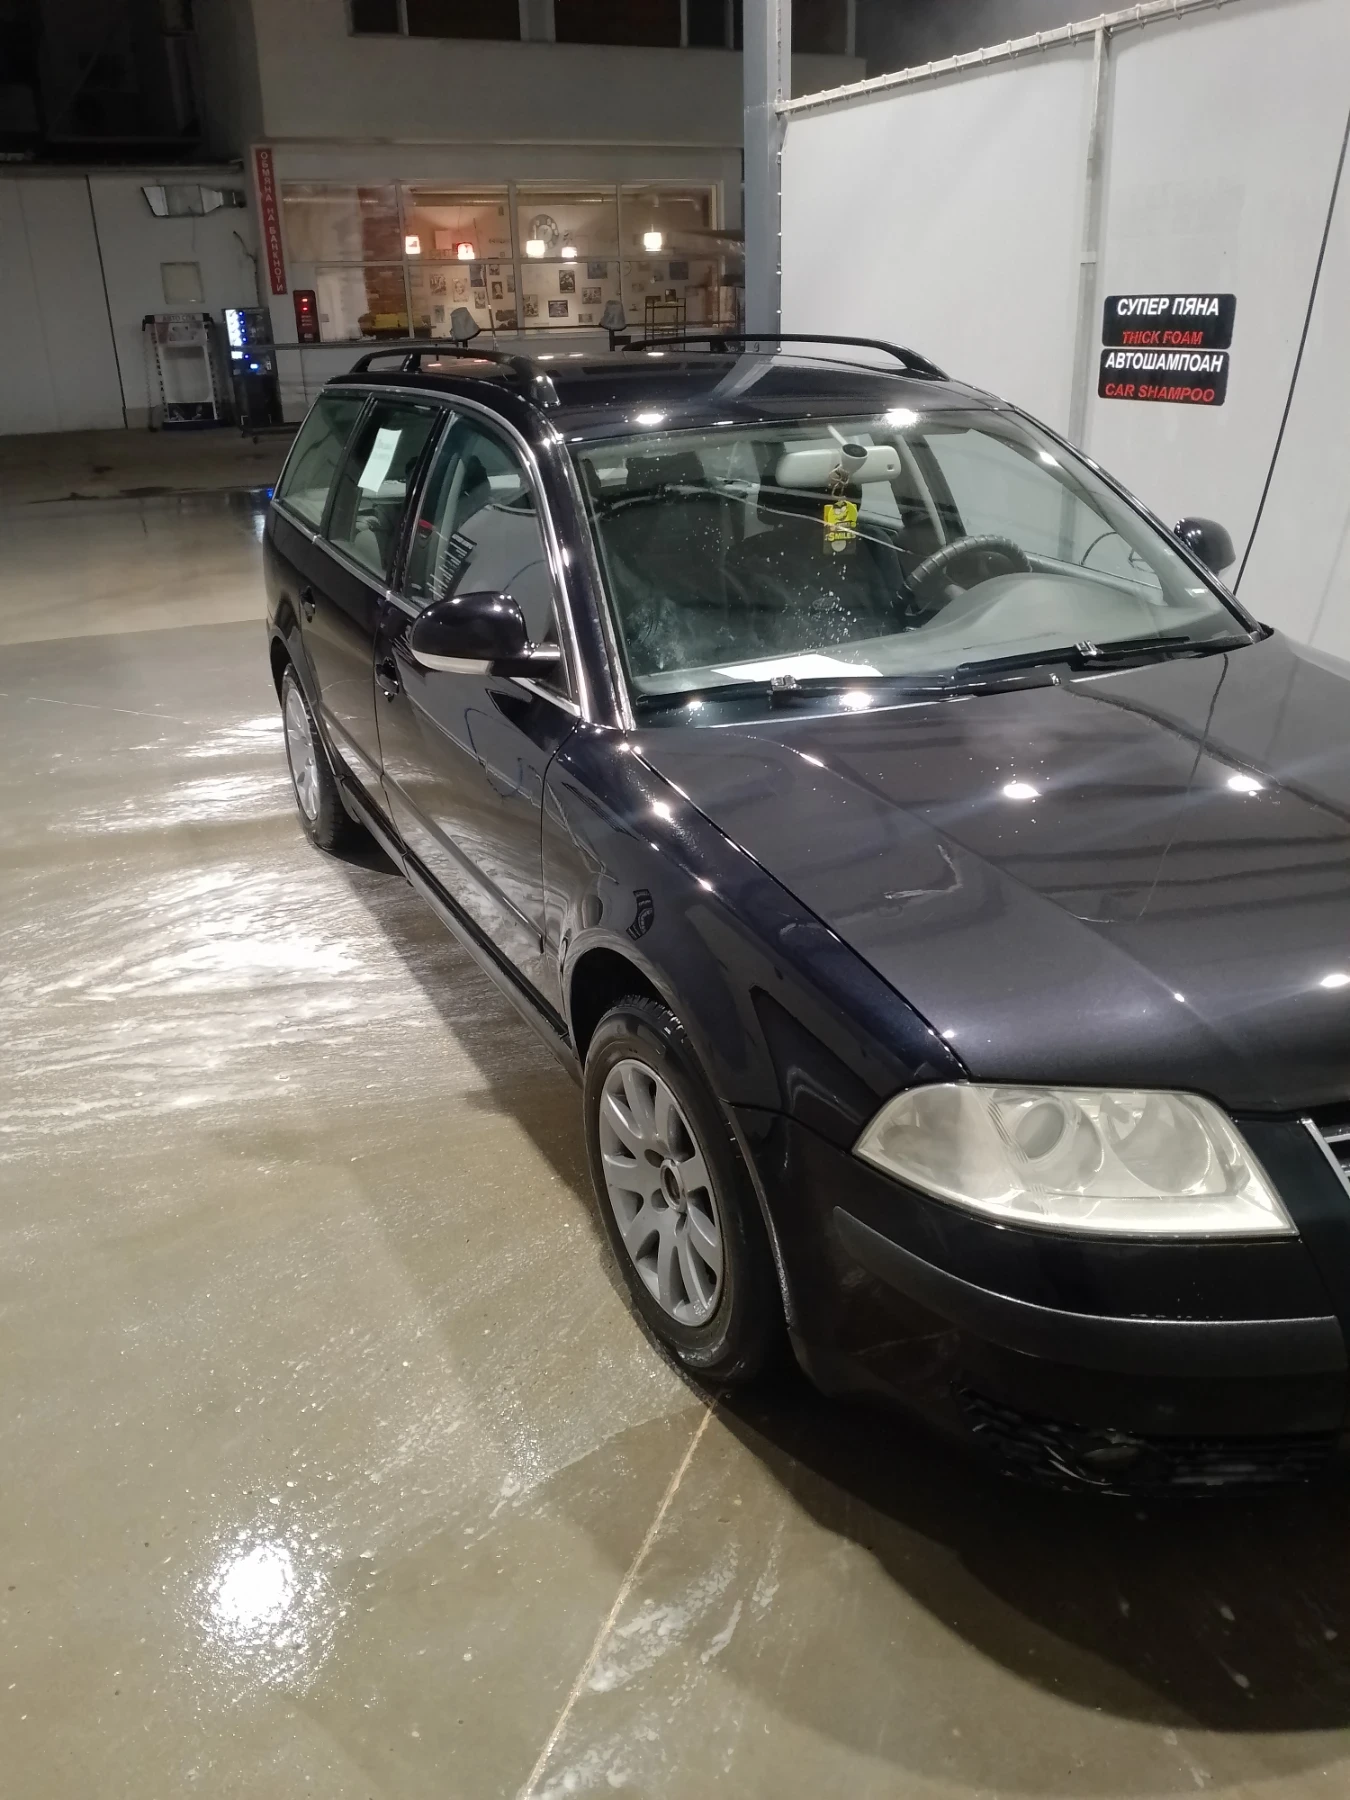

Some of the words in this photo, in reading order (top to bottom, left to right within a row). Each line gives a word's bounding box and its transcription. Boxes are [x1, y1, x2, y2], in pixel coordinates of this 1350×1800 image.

[266, 208, 275, 221] НА
[269, 227, 284, 292] БАНКНОТИ
[1117, 298, 1169, 316] СУПЕР
[1172, 297, 1219, 316] ПЯНА
[1122, 331, 1160, 344] THICK
[1162, 331, 1203, 344] FOAM
[1105, 352, 1224, 372] АВТОШАМПОАН
[1105, 383, 1135, 397] CAR
[1138, 385, 1215, 402] SHAMPOO
